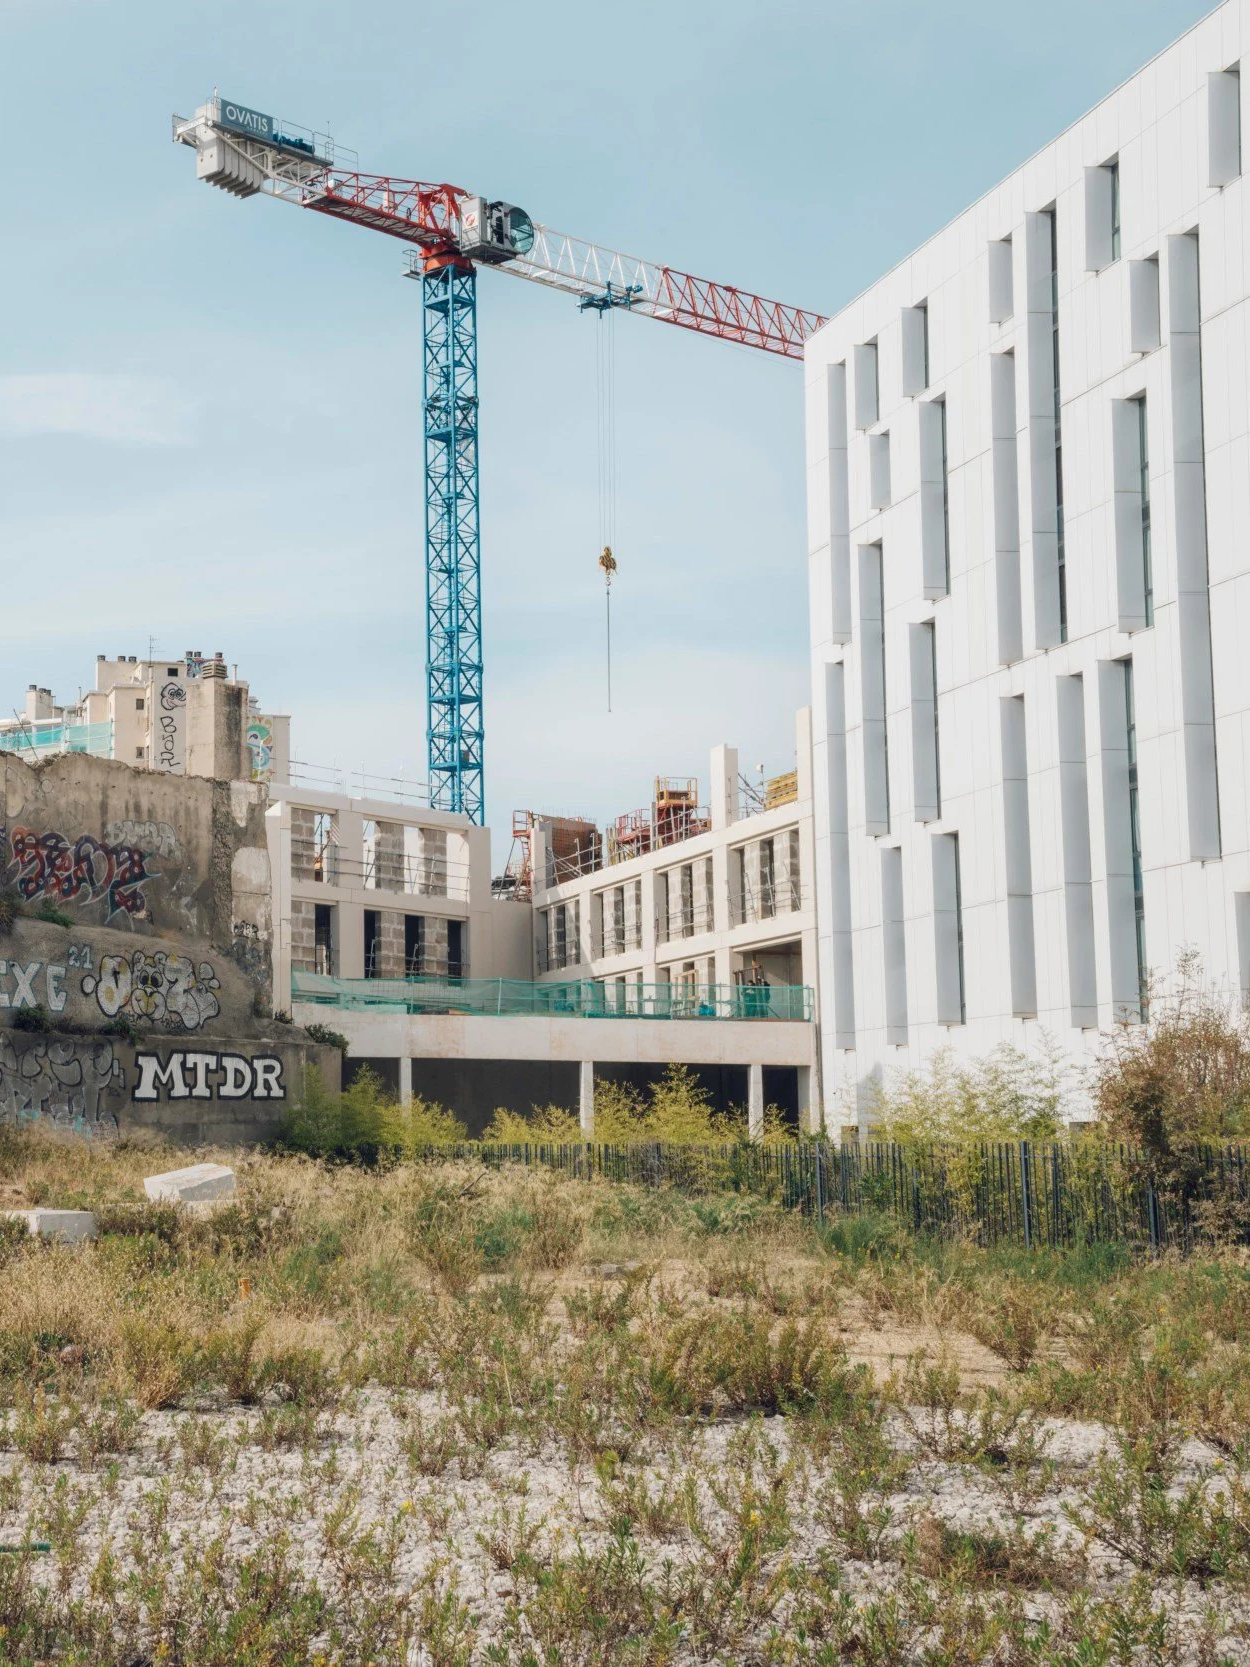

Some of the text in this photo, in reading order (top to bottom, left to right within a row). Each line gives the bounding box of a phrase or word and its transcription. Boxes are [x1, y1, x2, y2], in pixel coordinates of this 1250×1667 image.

[226, 105, 268, 132] OVATIS
[67, 945, 94, 971] 21
[132, 1049, 286, 1101] MTDR
